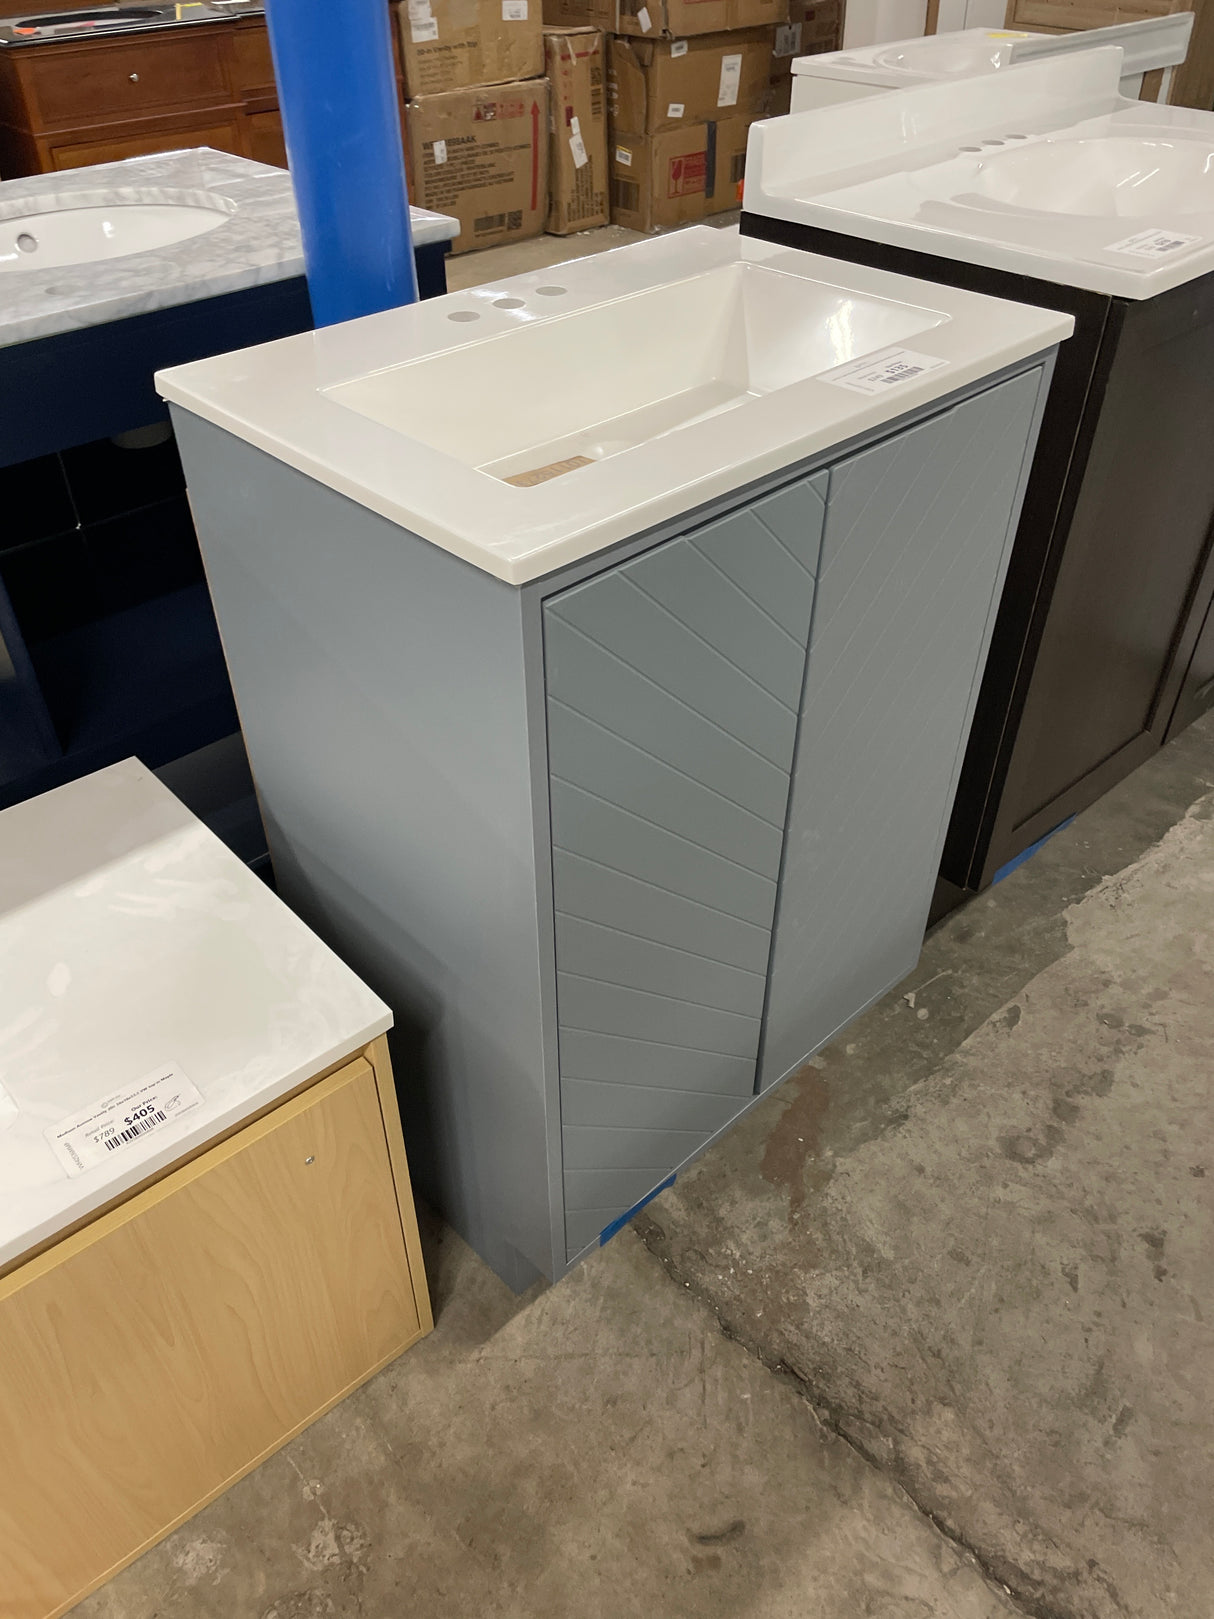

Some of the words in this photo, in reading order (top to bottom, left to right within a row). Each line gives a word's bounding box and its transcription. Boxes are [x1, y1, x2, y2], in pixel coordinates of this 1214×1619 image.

[131, 1104, 142, 1112] Our
[142, 1095, 157, 1106] Price:
[123, 1104, 156, 1126] $405
[93, 1127, 115, 1144] $789
